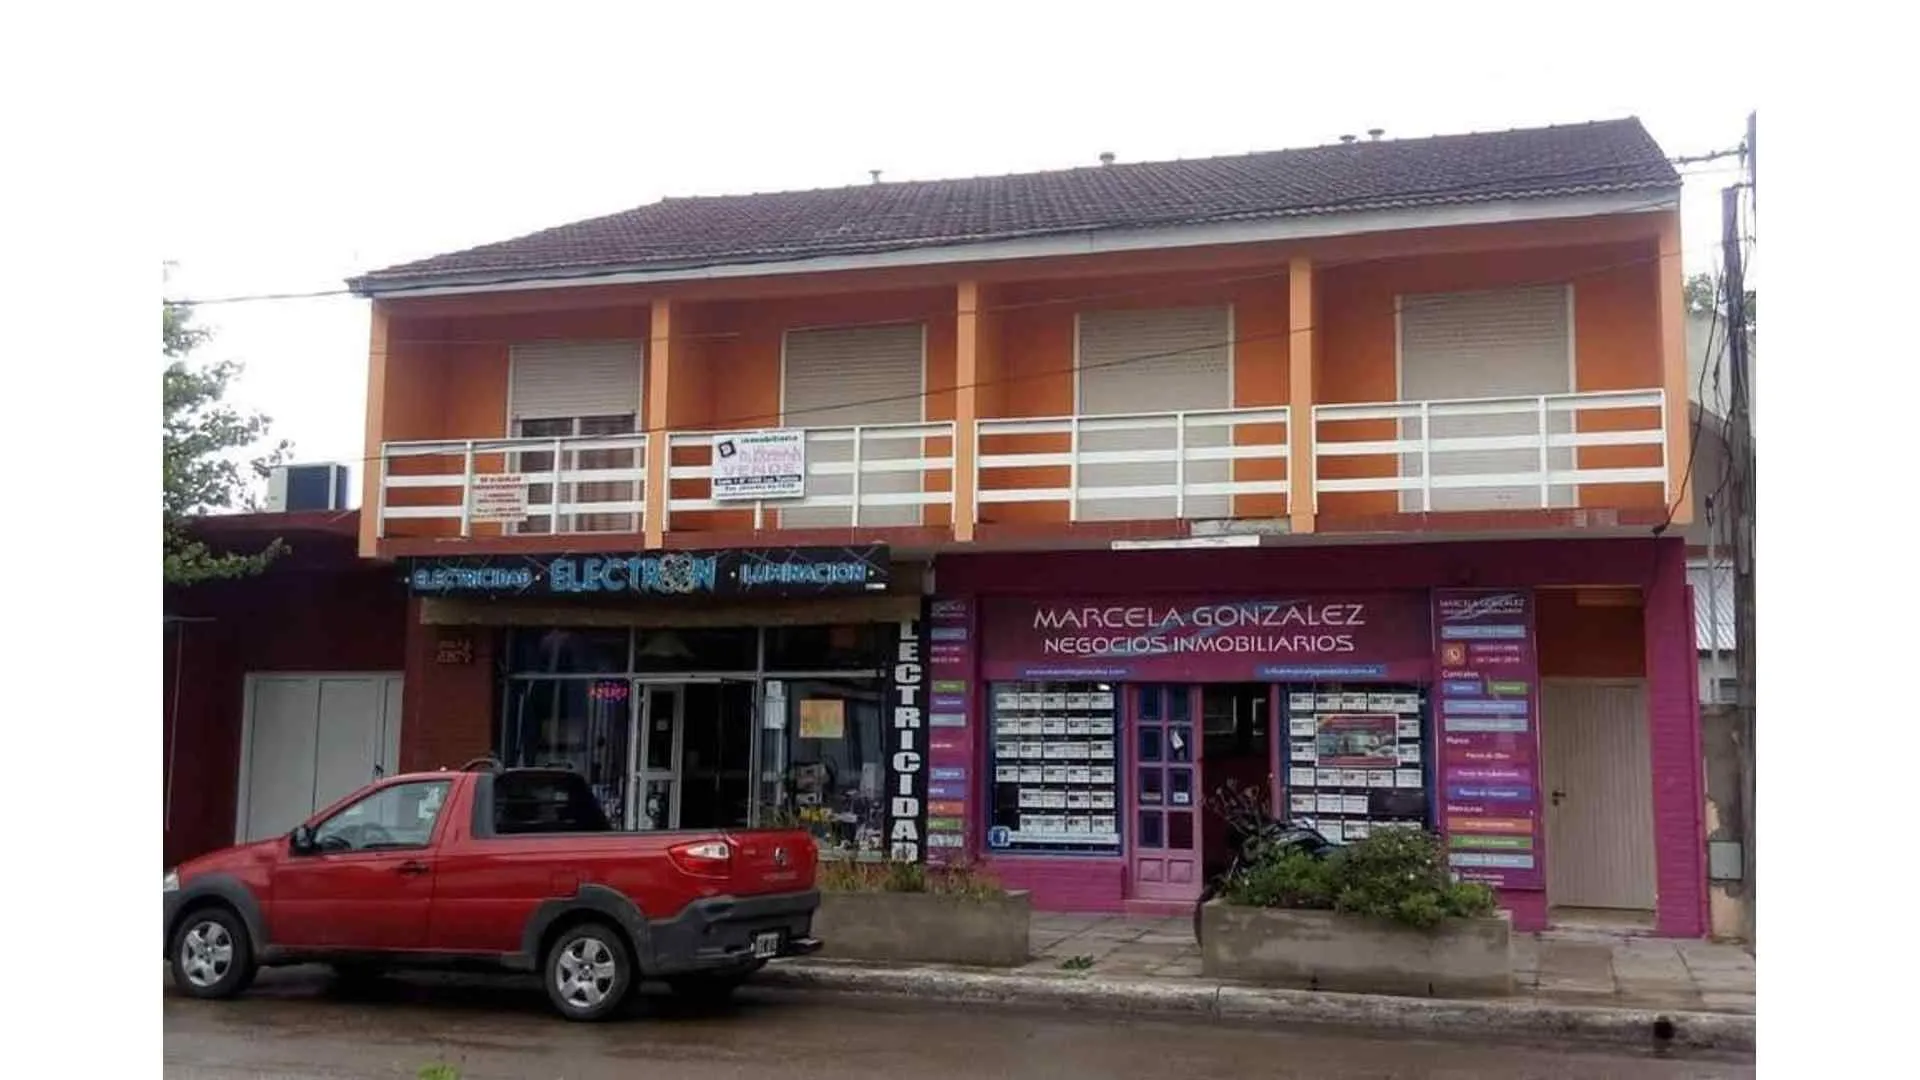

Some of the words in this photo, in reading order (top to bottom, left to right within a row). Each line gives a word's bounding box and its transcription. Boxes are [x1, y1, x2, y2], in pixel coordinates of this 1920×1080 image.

[413, 567, 533, 590] ELECTRICIDAD
[1033, 606, 1185, 629] MARCELA
[1191, 603, 1366, 627] GONZALEZ
[1044, 636, 1170, 655] NEGOCIOS
[1173, 634, 1355, 653] INMOBILIARIOS
